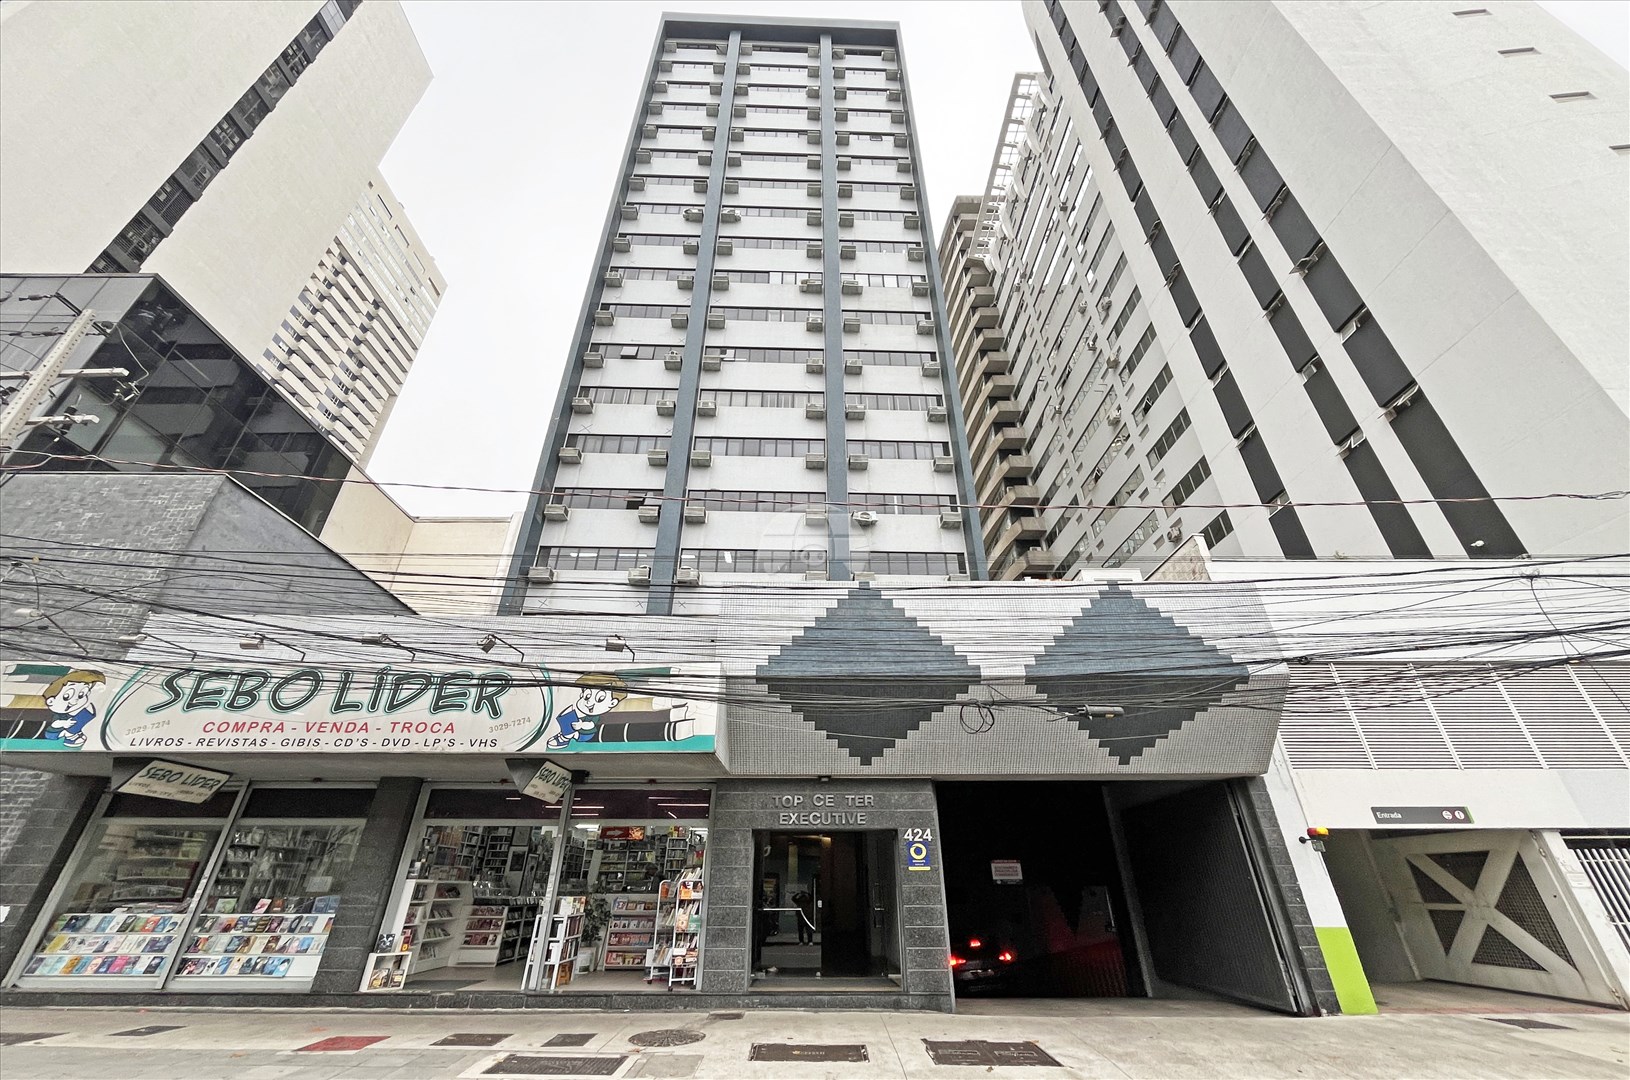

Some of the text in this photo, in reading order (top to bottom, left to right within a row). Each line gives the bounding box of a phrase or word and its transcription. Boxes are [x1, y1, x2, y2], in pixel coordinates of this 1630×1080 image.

[147, 666, 323, 713] SEBO
[125, 719, 171, 736] 3029-7274
[202, 721, 285, 734] COMPRA
[305, 721, 369, 734] VENDA
[390, 721, 455, 734] TROCA
[488, 716, 531, 734] 3029-7274
[129, 737, 184, 747] LIVROS
[196, 737, 268, 747] REVISTAS
[280, 738, 321, 747] GIBIS
[333, 738, 369, 747] CD'S
[381, 738, 411, 747] DVD
[423, 738, 456, 747] LP'S
[469, 738, 498, 748] VHS
[138, 766, 184, 783] SEBO
[772, 794, 803, 808] TOP
[779, 812, 867, 826] EXECUTIVE
[1376, 811, 1402, 819] Entrada
[903, 827, 933, 842] 424
